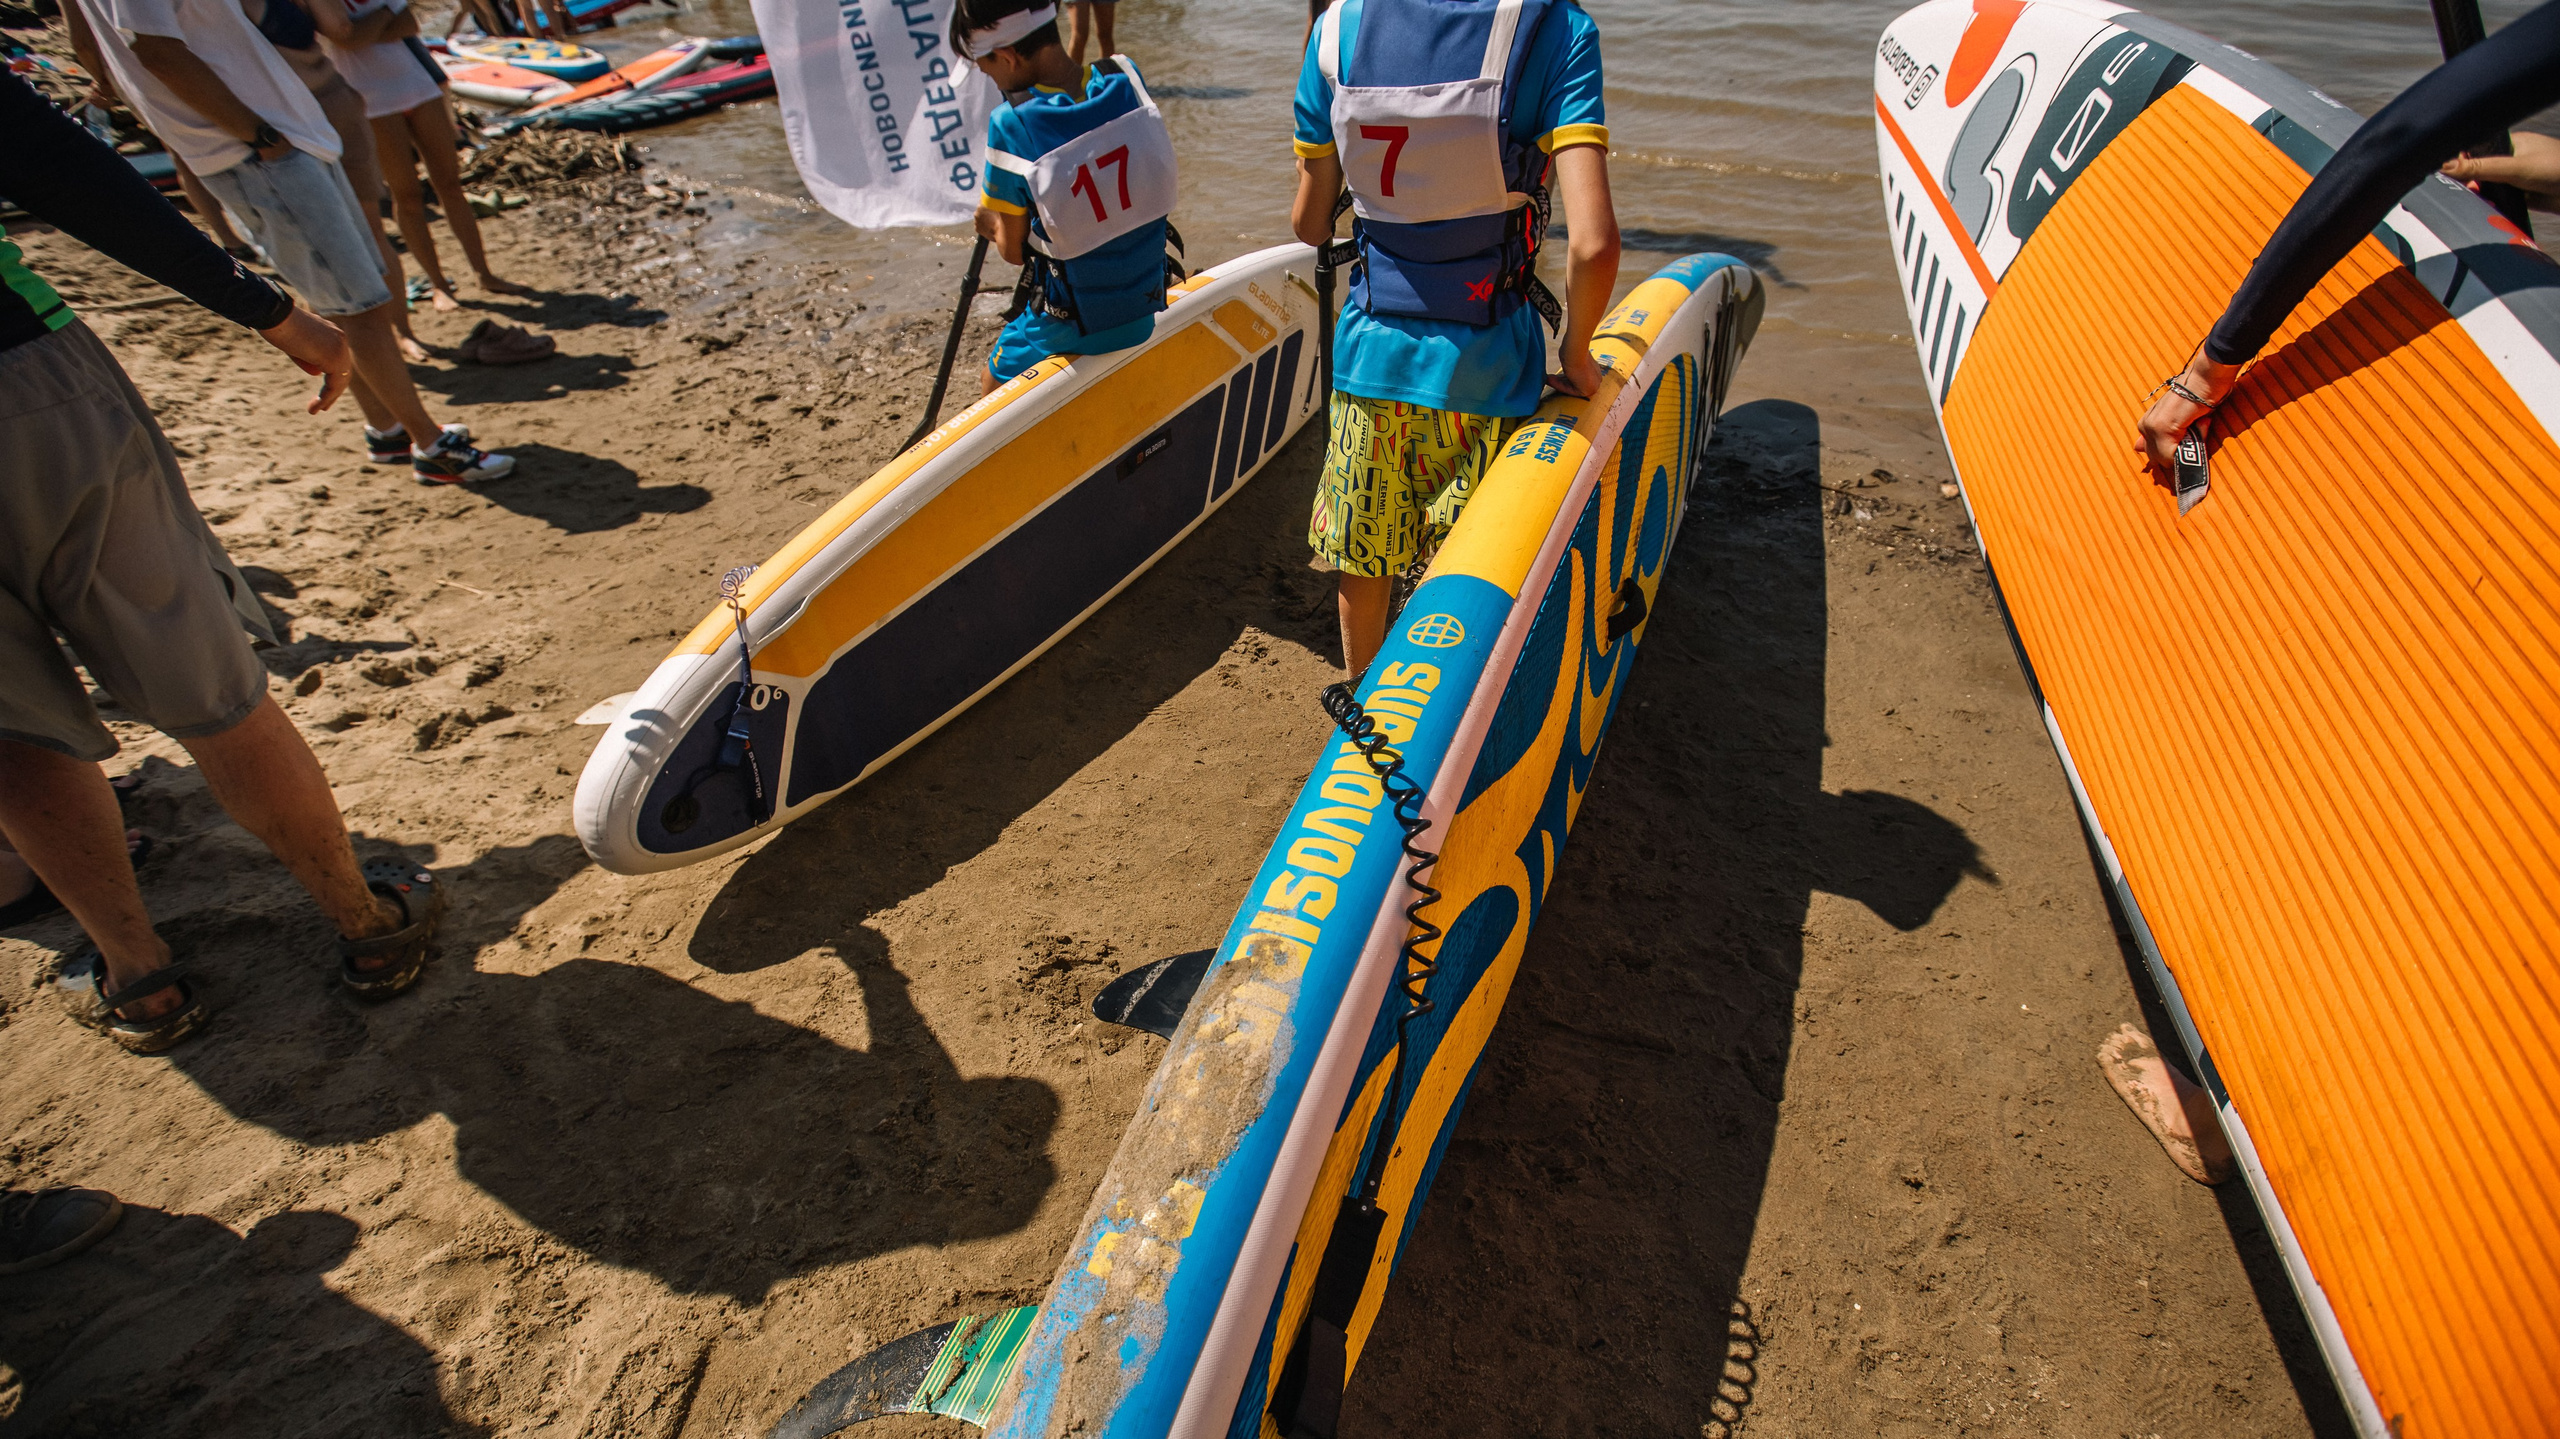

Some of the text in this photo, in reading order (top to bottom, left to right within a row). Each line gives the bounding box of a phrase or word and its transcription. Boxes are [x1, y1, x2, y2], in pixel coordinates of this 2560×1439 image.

[1070, 143, 1132, 223] 17
[1359, 124, 1409, 198] 7
[1247, 281, 1291, 326] GLADIATOR
[1252, 320, 1270, 340] ELITE
[947, 379, 1021, 429] GLADIATOR
[1358, 416, 1368, 457] TERMIT
[1534, 413, 1579, 464] THICKNESS
[1379, 479, 1388, 517] TERMIT
[1385, 523, 1394, 558] TERMIT
[748, 751, 763, 799] GLADIATOR
